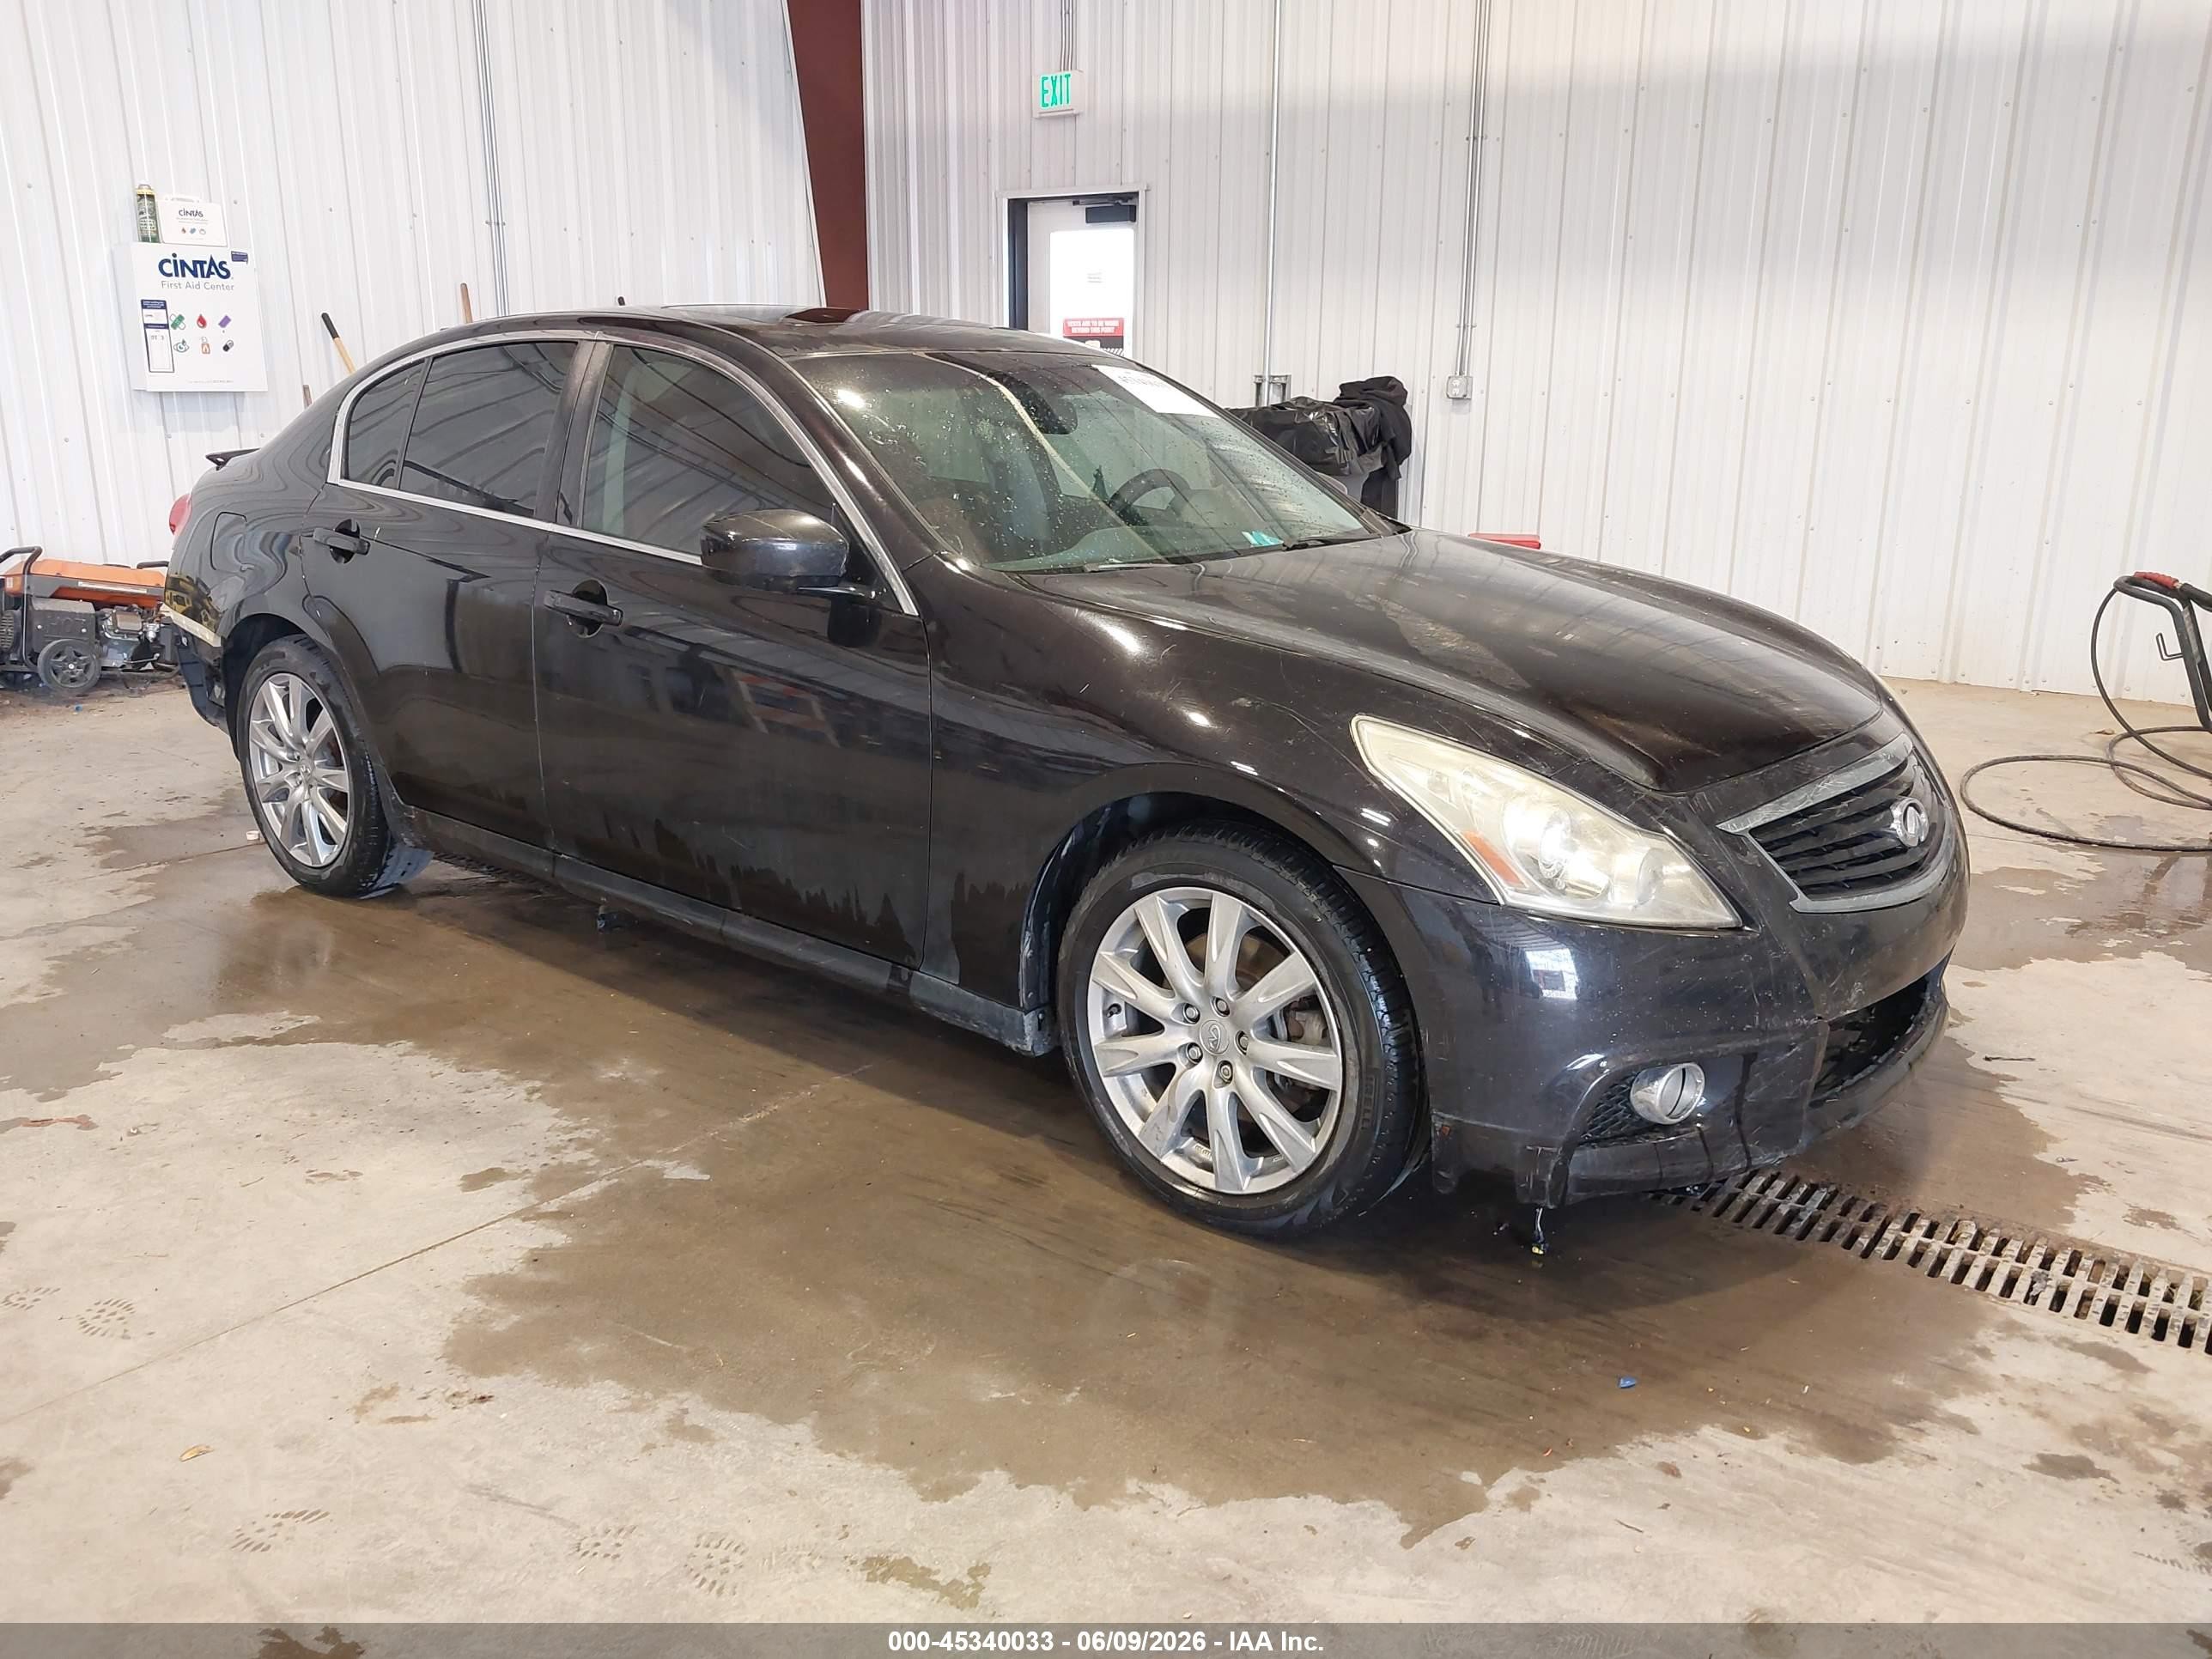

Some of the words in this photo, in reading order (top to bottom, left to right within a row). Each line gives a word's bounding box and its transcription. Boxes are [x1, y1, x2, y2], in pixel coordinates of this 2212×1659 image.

[1041, 73, 1071, 107] EXIT
[161, 281, 182, 289] First
[185, 282, 201, 290] Aid
[204, 283, 234, 291] Center
